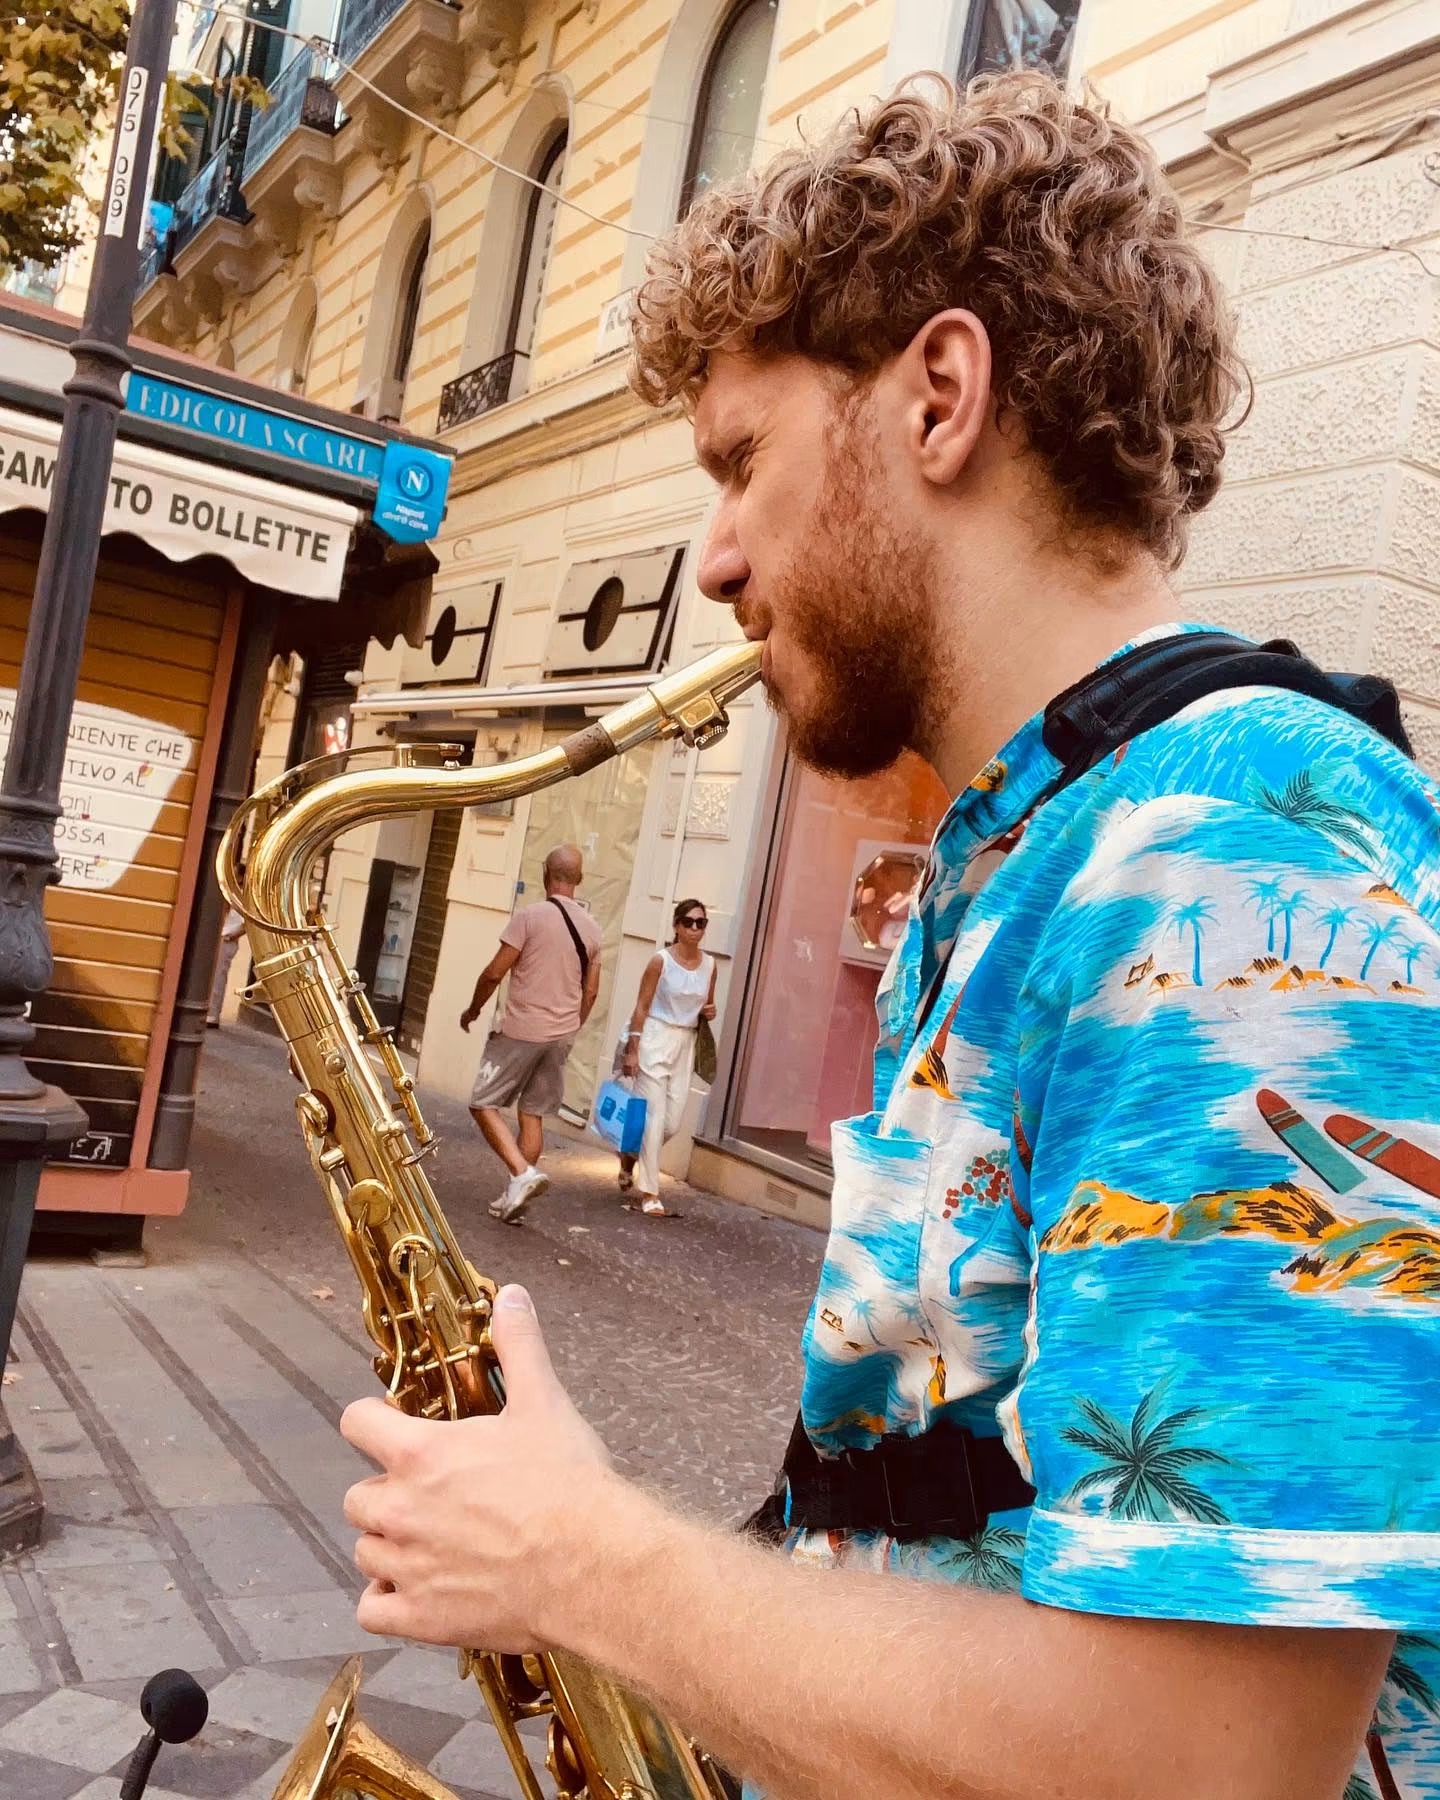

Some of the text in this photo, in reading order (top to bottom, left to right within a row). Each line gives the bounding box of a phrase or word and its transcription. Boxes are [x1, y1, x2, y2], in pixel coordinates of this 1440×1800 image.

[110, 71, 142, 217] 075 069
[406, 469, 425, 493] N
[168, 493, 331, 563] BOLLETTE
[145, 739, 185, 761] CHE
